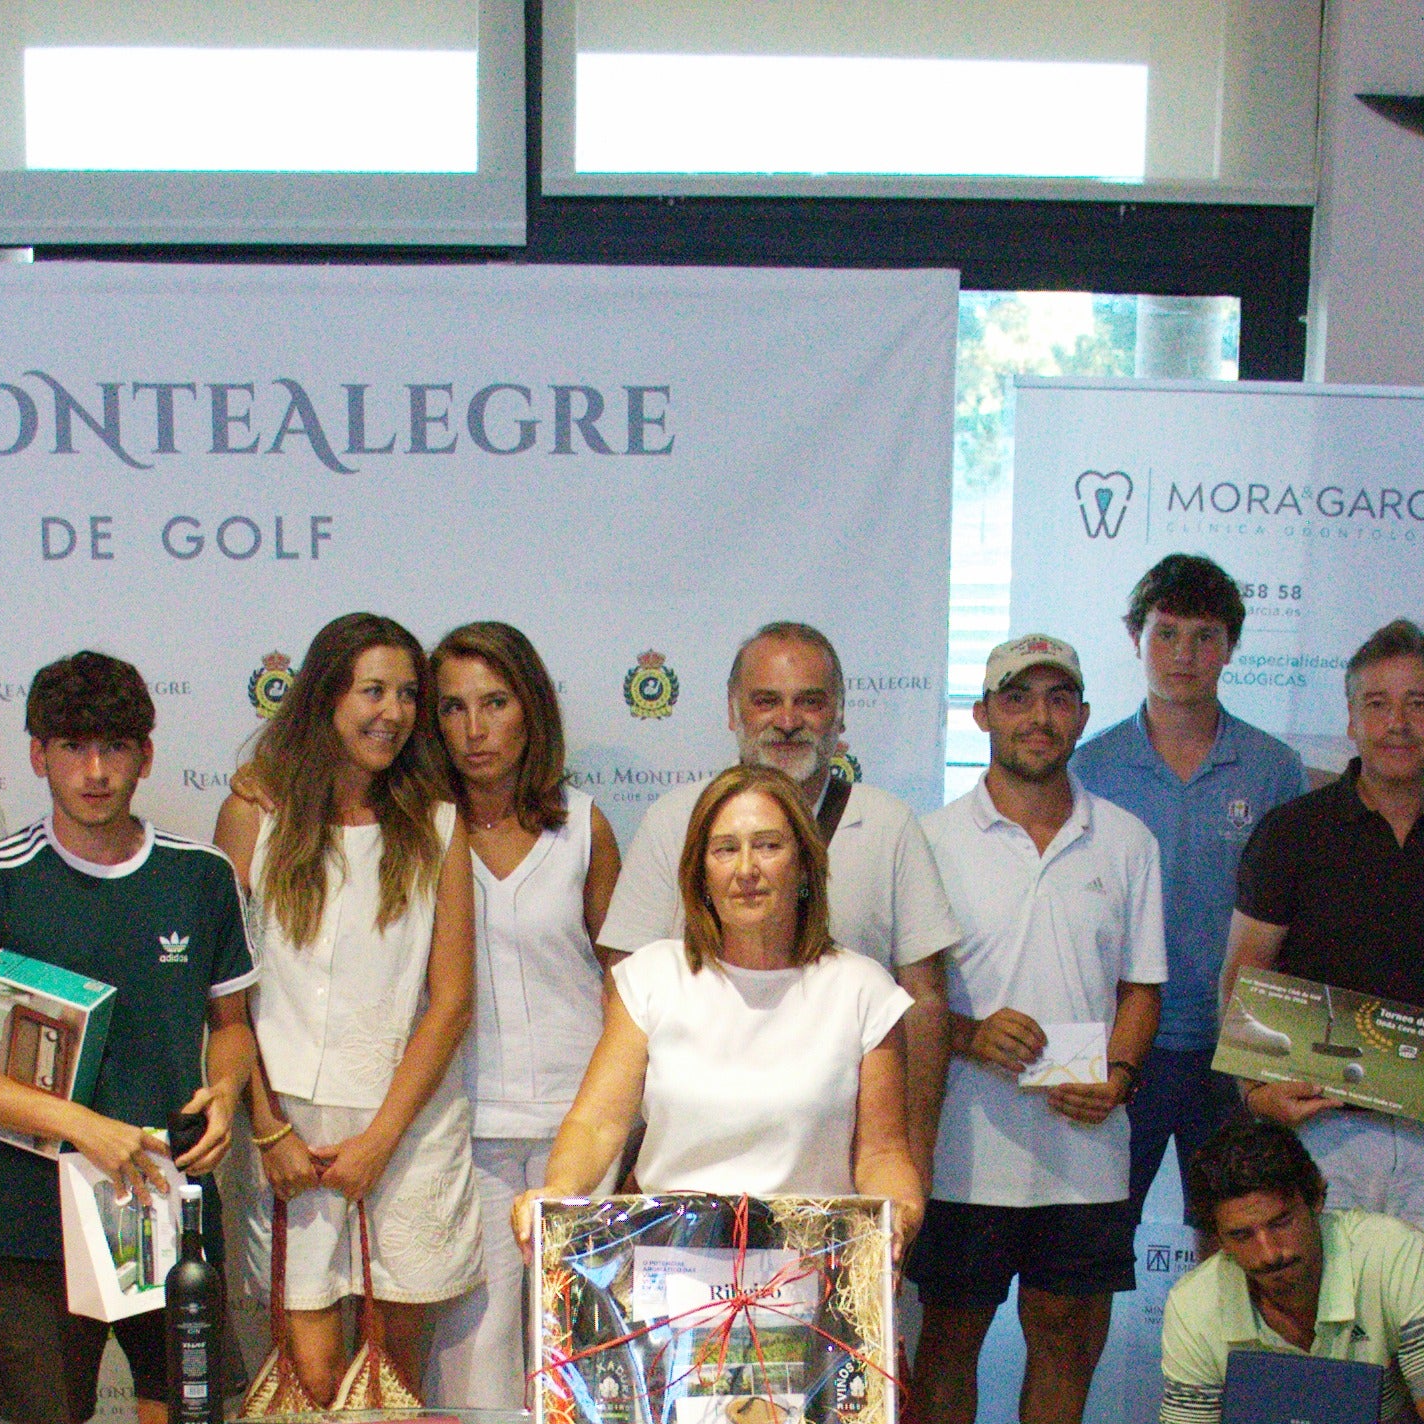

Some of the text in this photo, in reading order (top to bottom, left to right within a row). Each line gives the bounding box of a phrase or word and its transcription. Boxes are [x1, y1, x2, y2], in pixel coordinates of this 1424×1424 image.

[1167, 481, 1302, 516] MORA
[41, 515, 113, 561] DE
[162, 514, 334, 561] GOLF
[1278, 584, 1303, 600] 58
[846, 676, 931, 694] TEALEGRE
[158, 953, 189, 964] adidas
